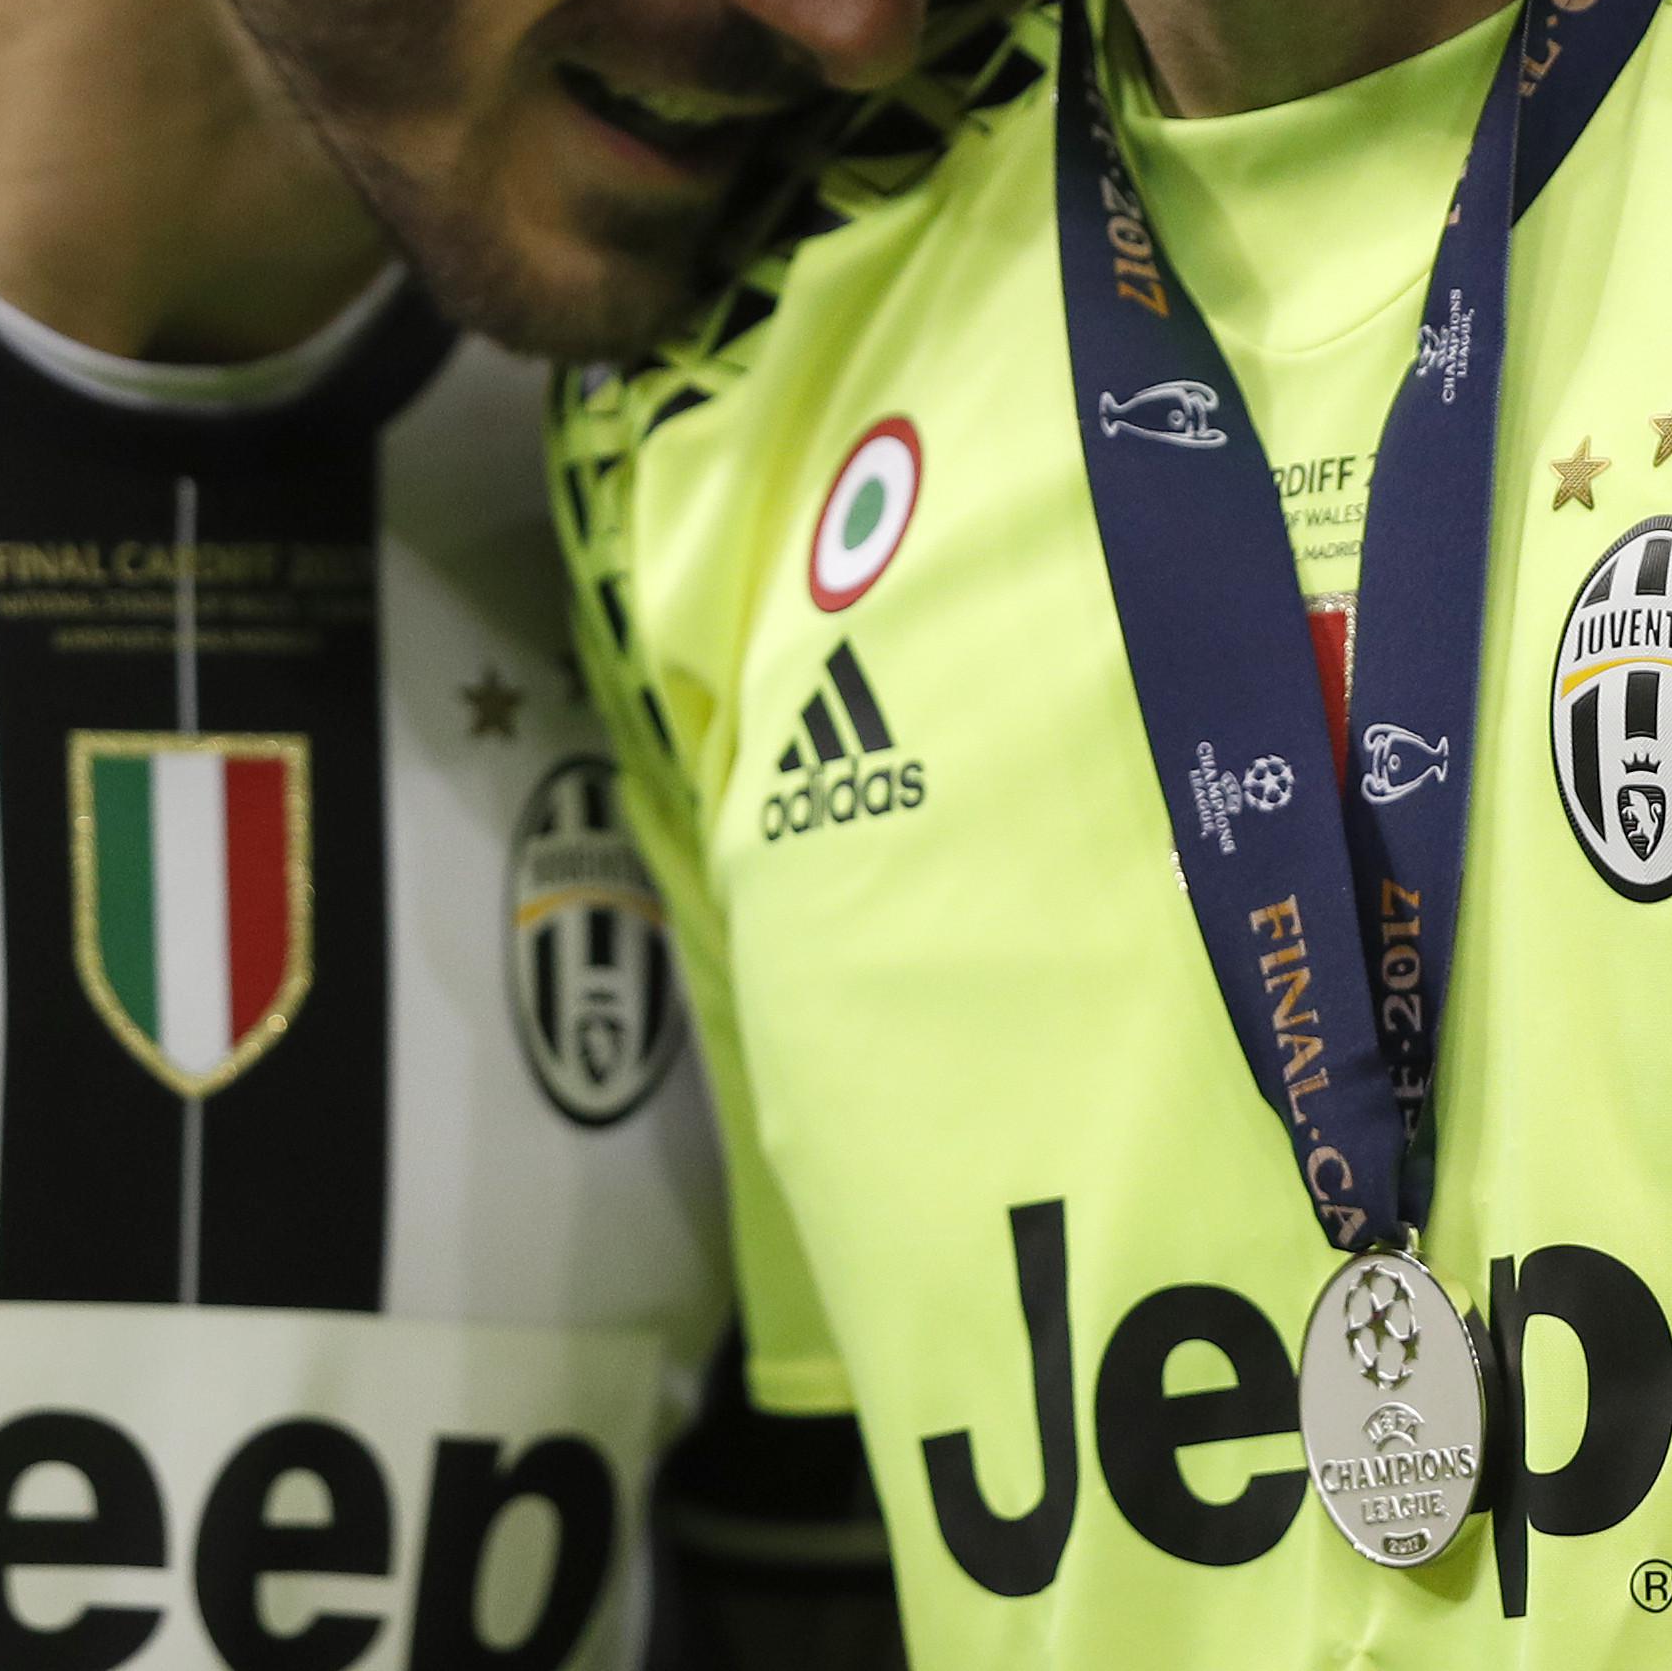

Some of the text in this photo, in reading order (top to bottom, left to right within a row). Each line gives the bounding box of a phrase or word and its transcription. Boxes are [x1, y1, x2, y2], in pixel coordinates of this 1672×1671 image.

[1441, 288, 1462, 405] CHAMPIONS
[1305, 503, 1365, 527] WALES
[760, 757, 925, 842] adidas
[1196, 740, 1236, 855] CHAMPIONS
[1367, 1409, 1420, 1445] UEFA
[1321, 1444, 1478, 1493] CHAMPIONS
